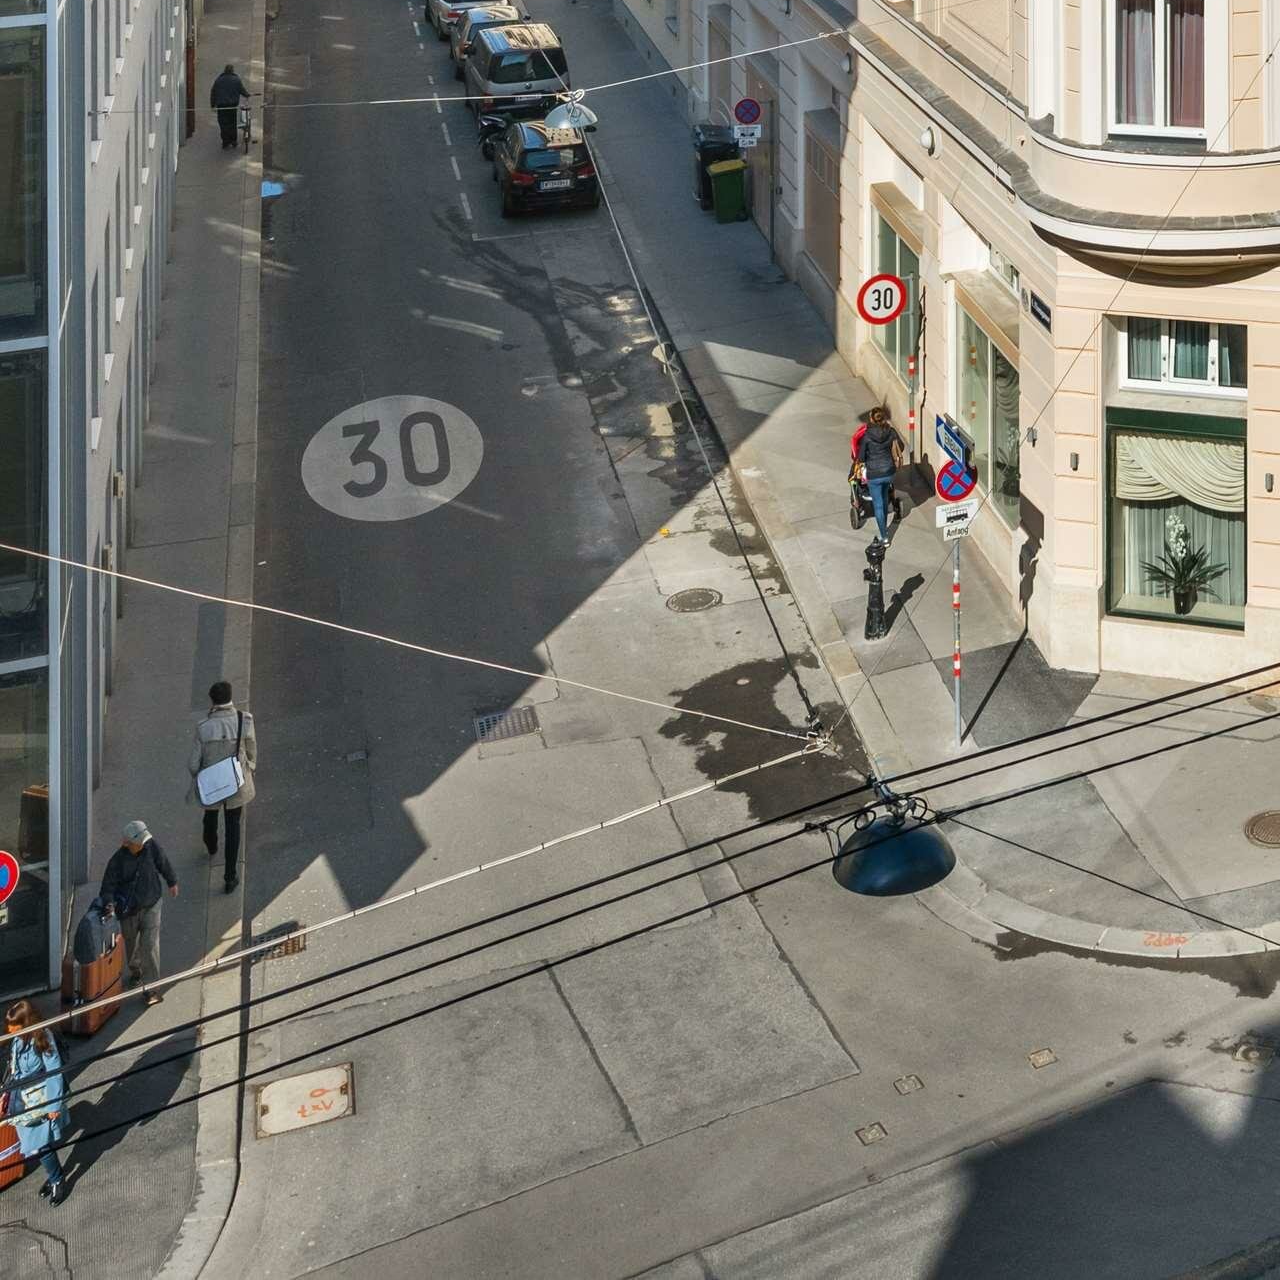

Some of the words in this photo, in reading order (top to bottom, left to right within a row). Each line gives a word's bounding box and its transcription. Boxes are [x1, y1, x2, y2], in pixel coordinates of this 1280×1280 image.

[871, 287, 894, 311] 30
[342, 411, 451, 499] 30
[946, 527, 969, 539] Anfang
